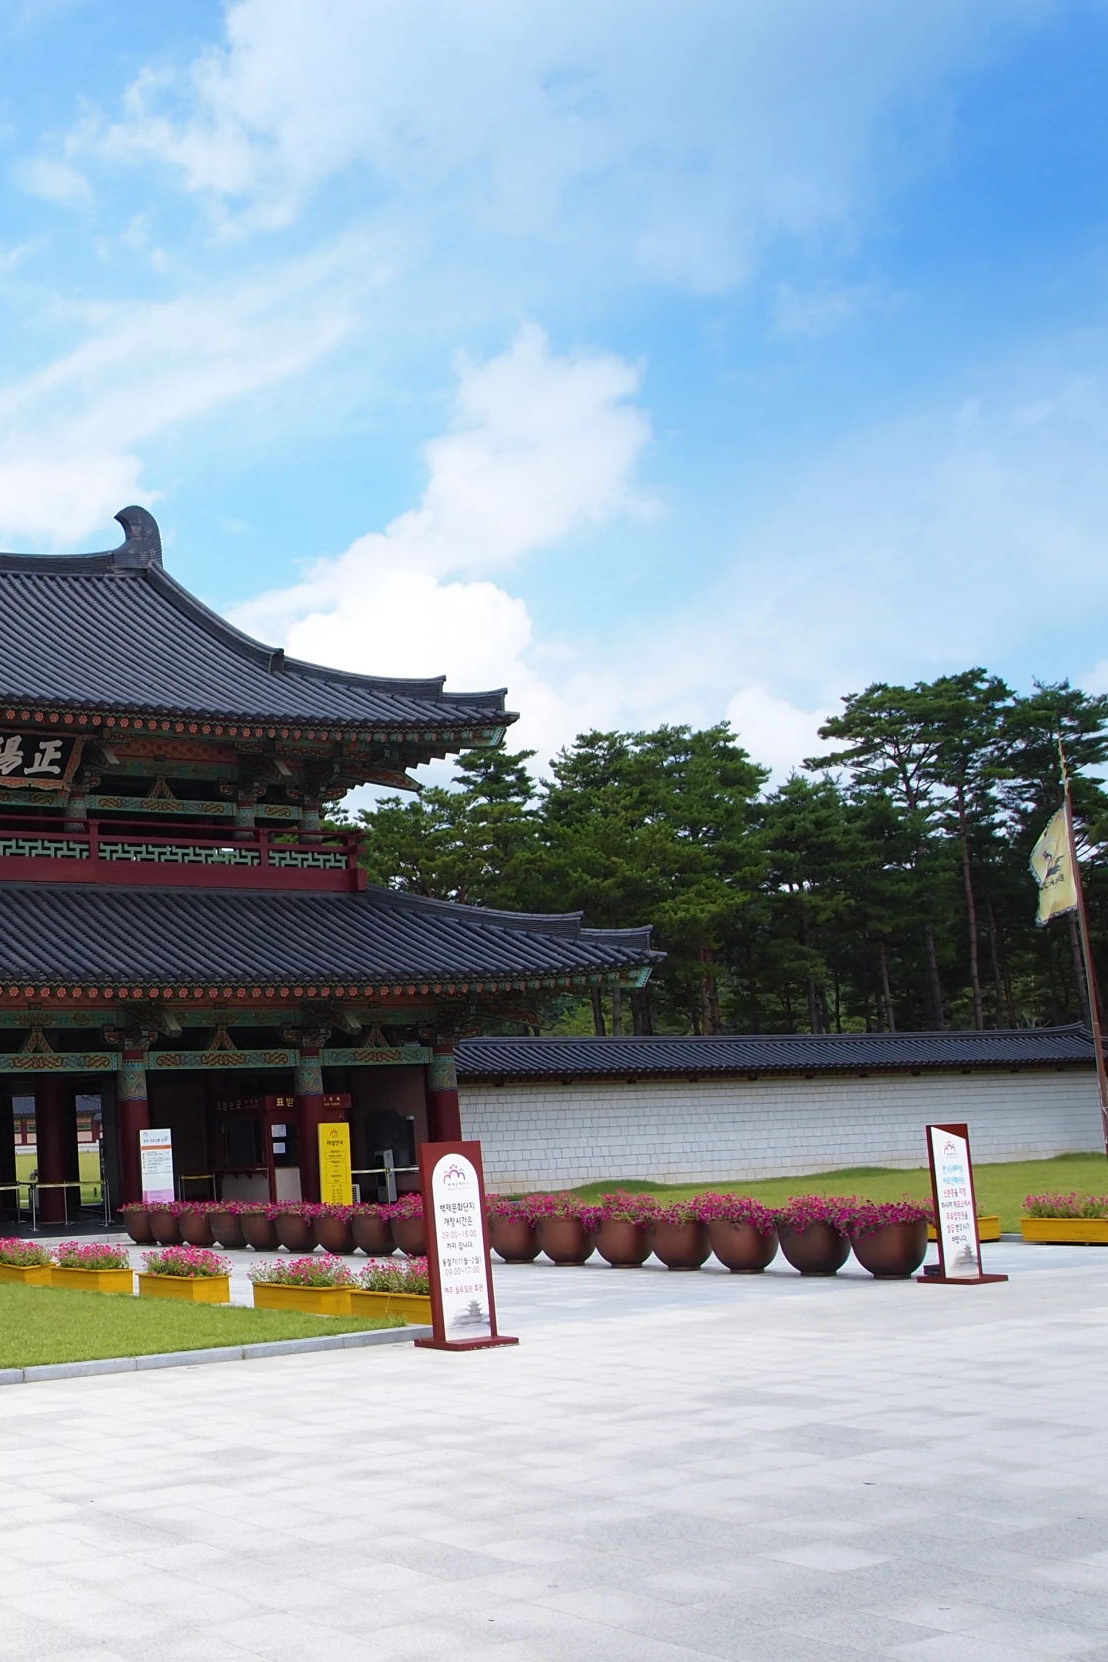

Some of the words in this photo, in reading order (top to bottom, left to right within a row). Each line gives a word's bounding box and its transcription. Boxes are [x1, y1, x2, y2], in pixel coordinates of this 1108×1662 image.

[439, 1202, 475, 1213] 백제문화단지
[444, 1216, 473, 1228] 개장시간은
[447, 1242, 457, 1250] 까지
[444, 1286, 453, 1295] 매주
[455, 1284, 473, 1295] 월요일은
